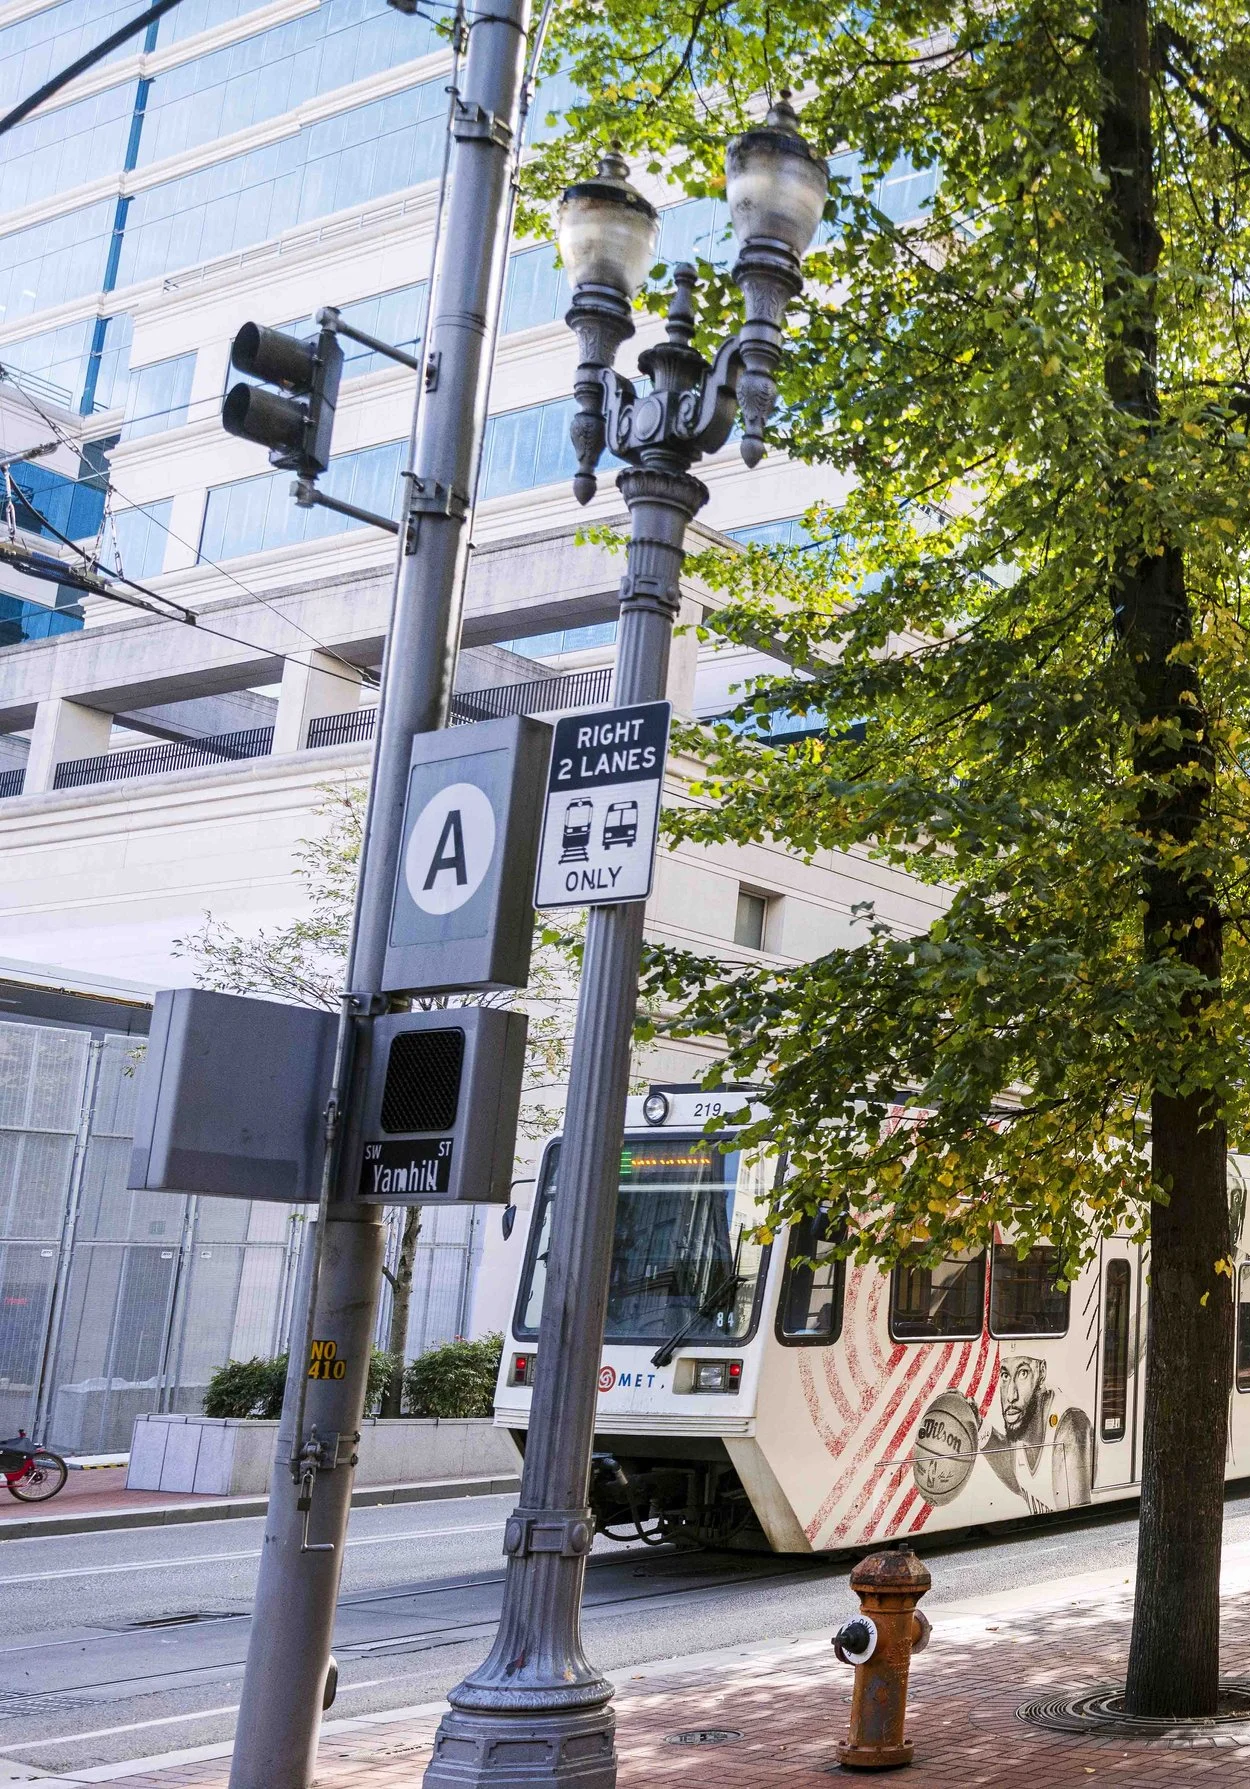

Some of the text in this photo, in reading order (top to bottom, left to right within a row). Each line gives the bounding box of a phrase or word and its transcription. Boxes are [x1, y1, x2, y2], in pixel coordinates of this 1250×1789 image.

[577, 719, 644, 749] RIGHT
[557, 746, 657, 780] 2 LANES
[422, 809, 468, 891] A
[565, 866, 623, 892] ONLY
[694, 1102, 722, 1117] 219
[365, 1141, 452, 1160] SW ST
[373, 1160, 439, 1193] Yamhill
[311, 1340, 337, 1360] NO
[308, 1360, 346, 1380] 410
[918, 1418, 962, 1454] Wilson
